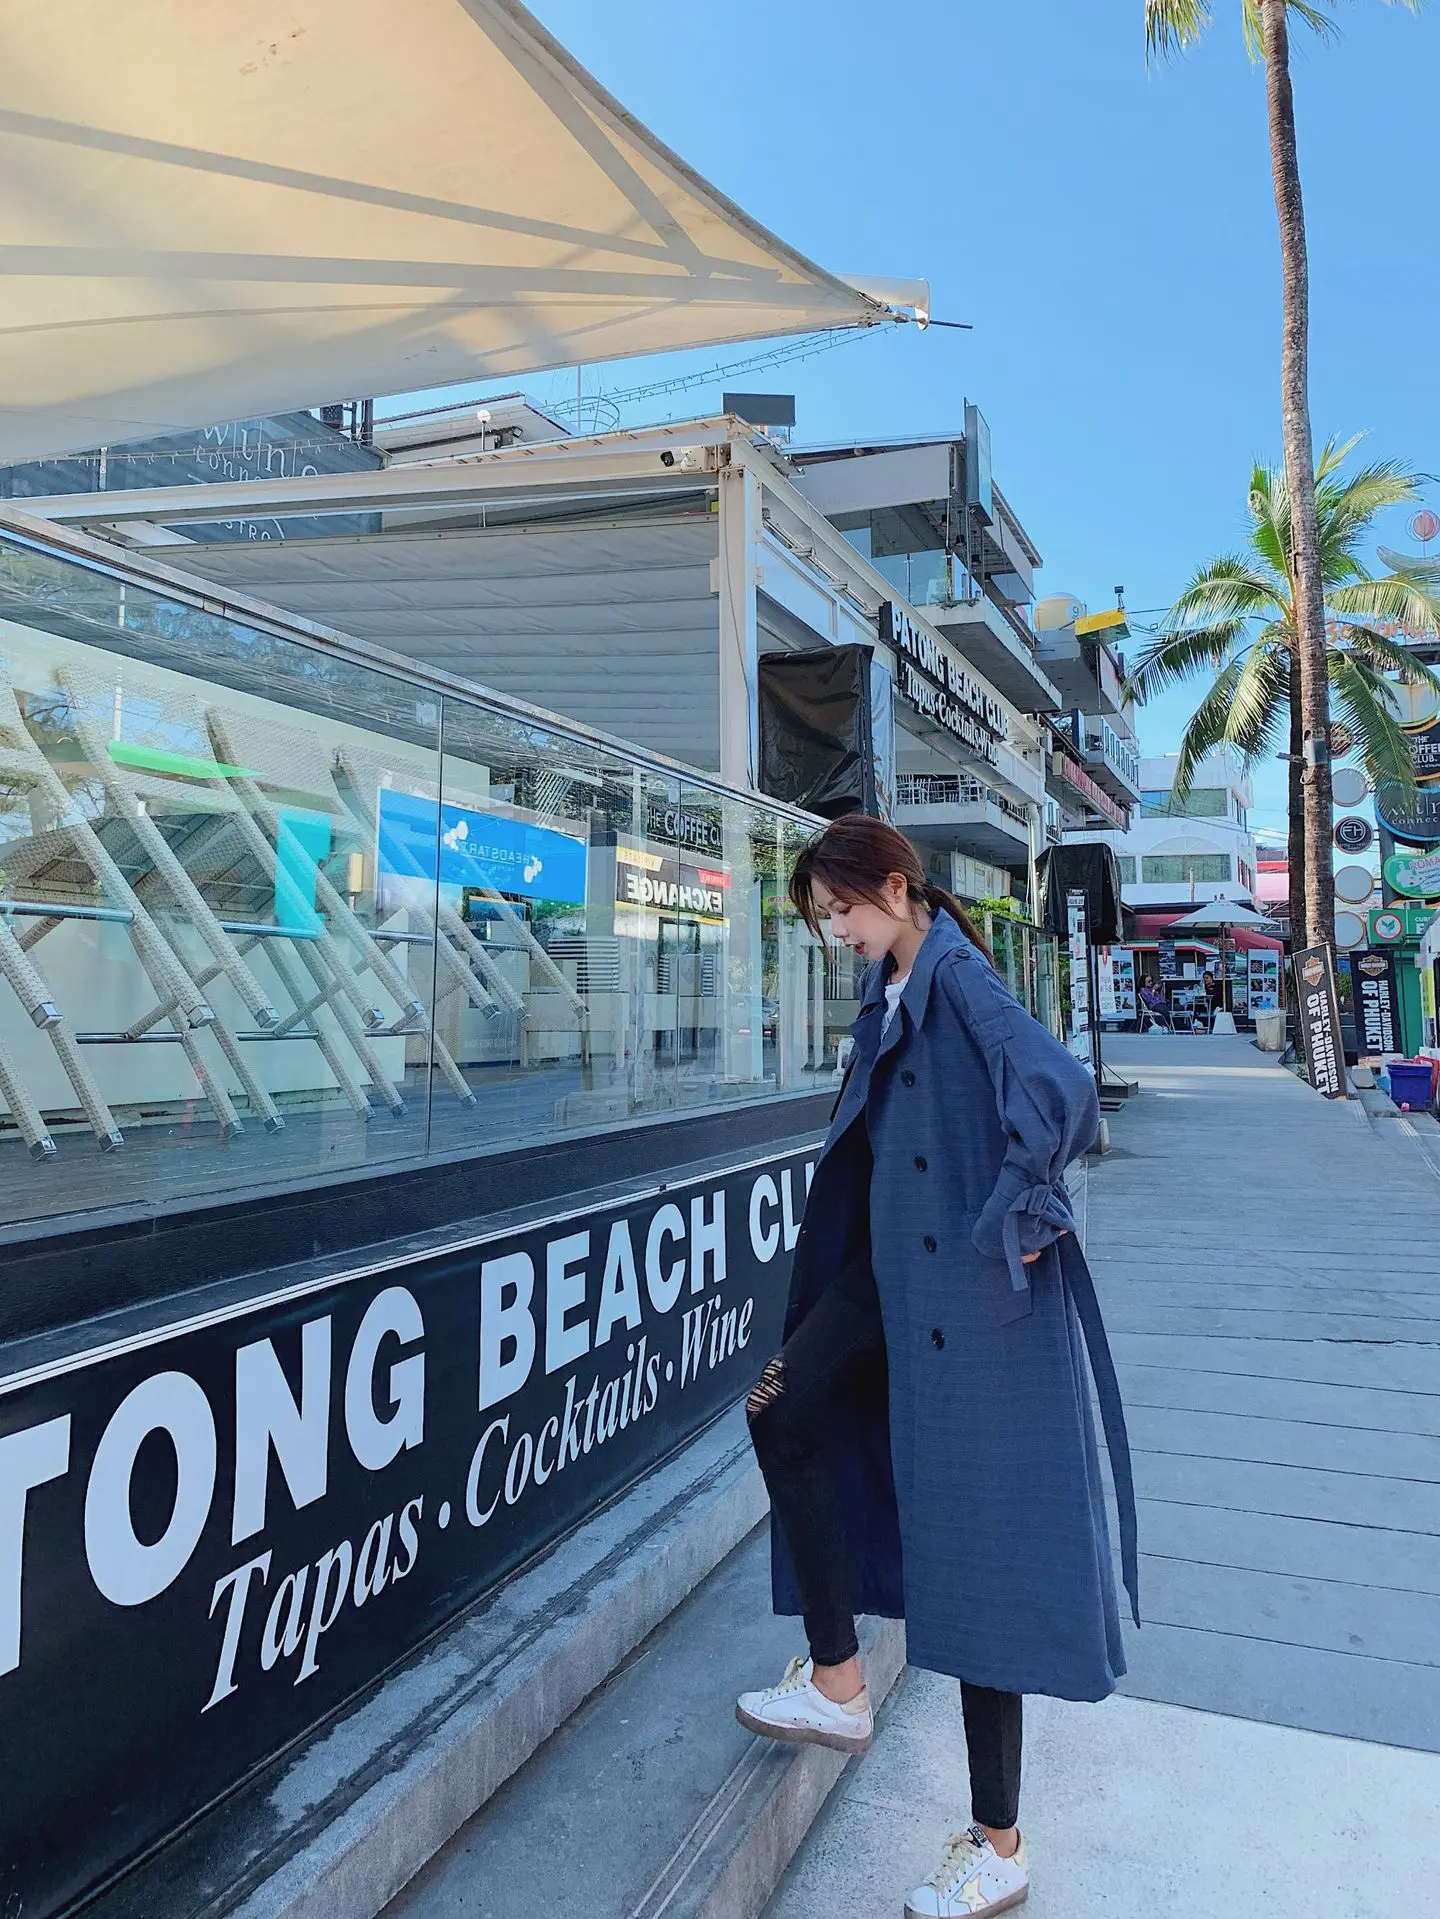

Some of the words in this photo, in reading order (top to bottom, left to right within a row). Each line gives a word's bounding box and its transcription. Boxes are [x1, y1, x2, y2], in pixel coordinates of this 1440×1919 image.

[891, 600, 945, 685] PATONG
[947, 658, 984, 719] BEACH
[985, 698, 1009, 740] CLUB
[1411, 736, 1430, 744] THE
[664, 810, 709, 846] COFFEE
[1306, 993, 1321, 1017] OF
[1361, 980, 1379, 997] OF
[1378, 980, 1394, 1052] HARLEY-DAVIDSON
[1309, 1020, 1331, 1094] PHUKET
[1318, 990, 1340, 1093] HARLEY-DAVIDSON
[1363, 999, 1383, 1052] PHUKET
[0, 1286, 426, 1677] TONG
[478, 1189, 728, 1412] BEACH
[200, 1494, 425, 1714] Tapas
[465, 1334, 662, 1528] Cocktails
[679, 1293, 755, 1391] Wine
